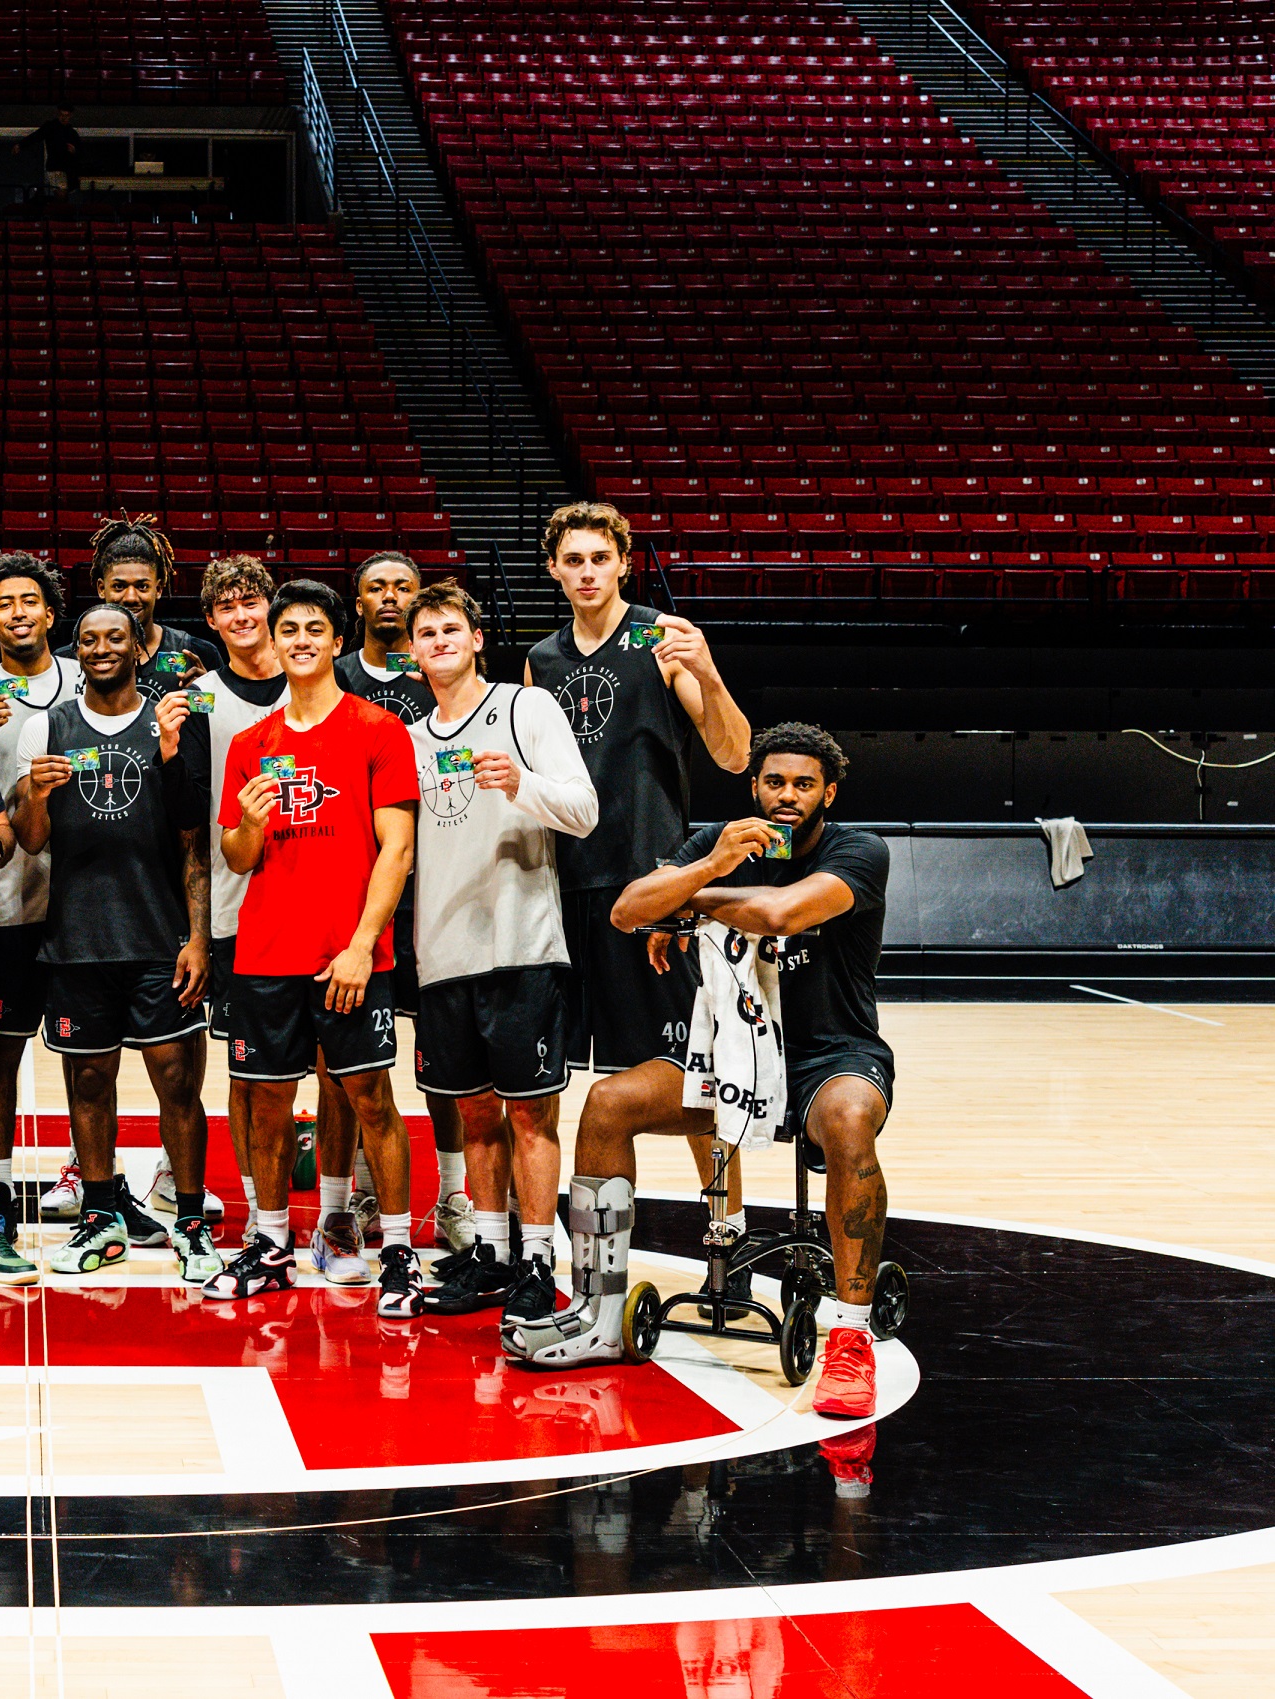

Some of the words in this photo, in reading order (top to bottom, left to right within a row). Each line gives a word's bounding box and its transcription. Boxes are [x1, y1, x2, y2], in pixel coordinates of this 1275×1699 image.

[618, 631, 643, 652] 4
[148, 678, 167, 694] STAT
[553, 685, 562, 697] AN
[565, 665, 594, 682] DIEGO
[599, 667, 621, 688] STATE
[400, 693, 423, 717] STATE
[485, 706, 498, 726] 6
[150, 721, 161, 737] 3
[576, 731, 604, 744] TECS
[100, 743, 119, 751] EGO
[126, 746, 150, 771] STATE
[91, 810, 129, 821] AZTECS
[436, 813, 468, 828] AZTECS
[371, 1007, 394, 1032] 23
[661, 1020, 688, 1043] 40
[536, 1036, 548, 1058] 6
